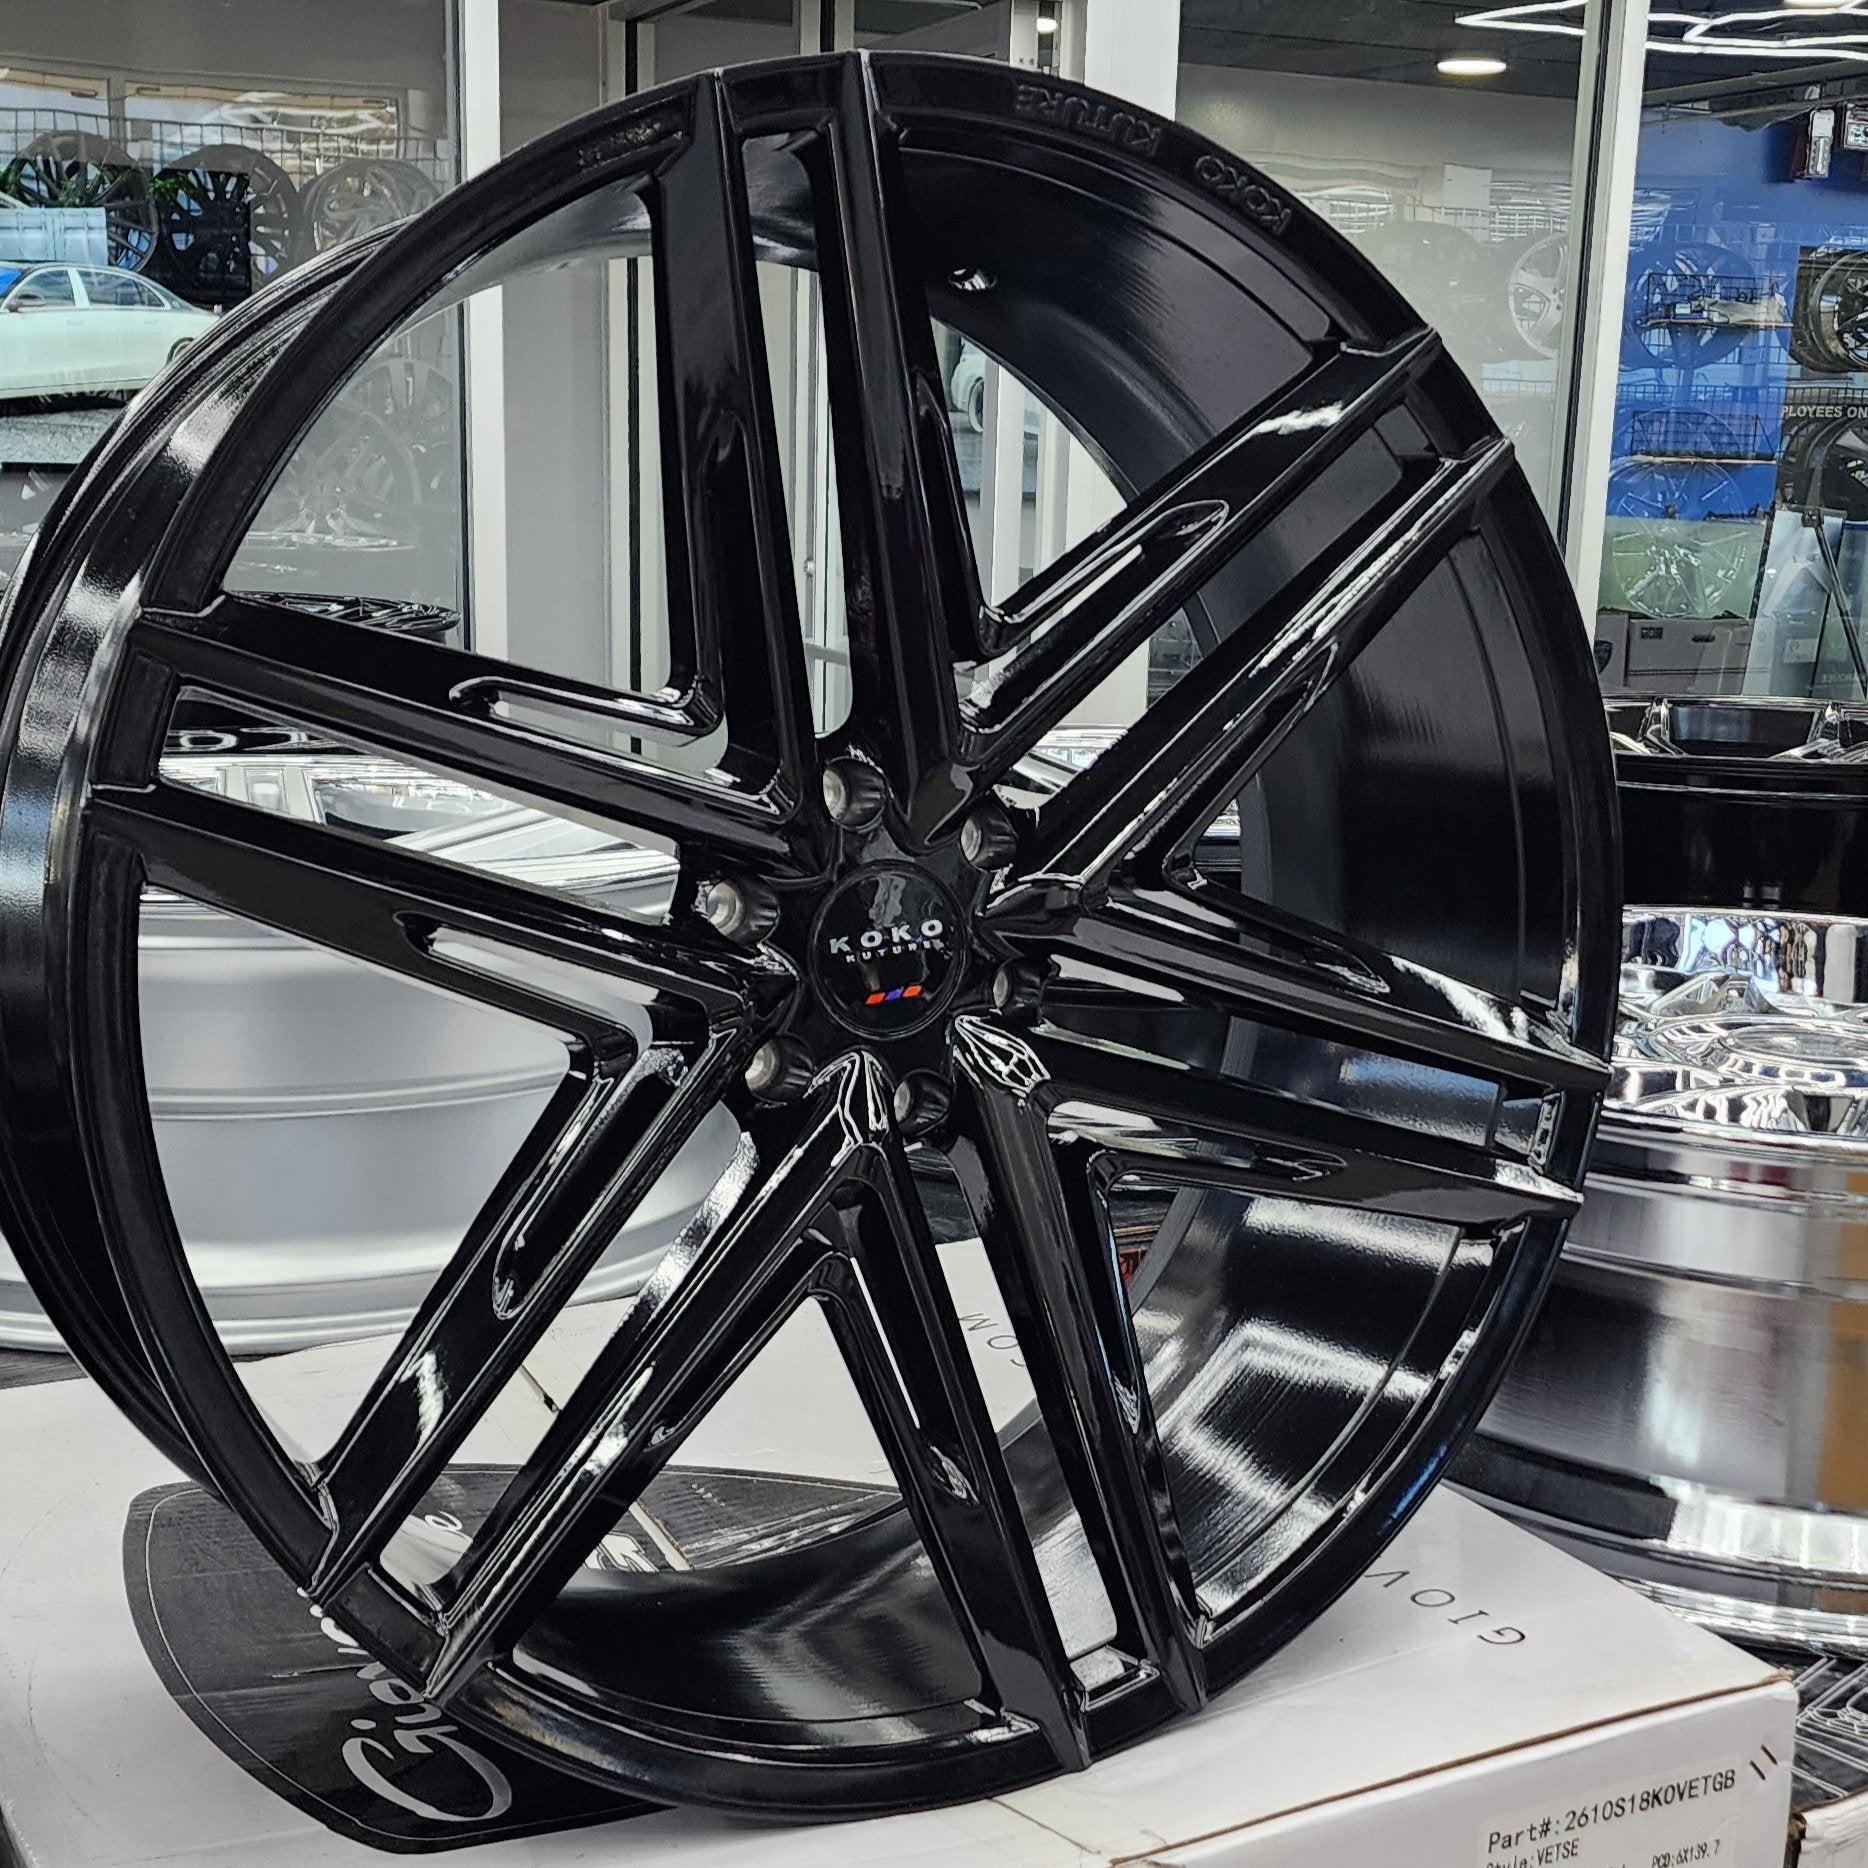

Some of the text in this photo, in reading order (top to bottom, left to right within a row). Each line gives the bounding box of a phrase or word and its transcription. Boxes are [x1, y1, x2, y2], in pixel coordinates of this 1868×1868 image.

[1015, 82, 1292, 236] KOKO KUTURE
[829, 919, 943, 955] KOKO
